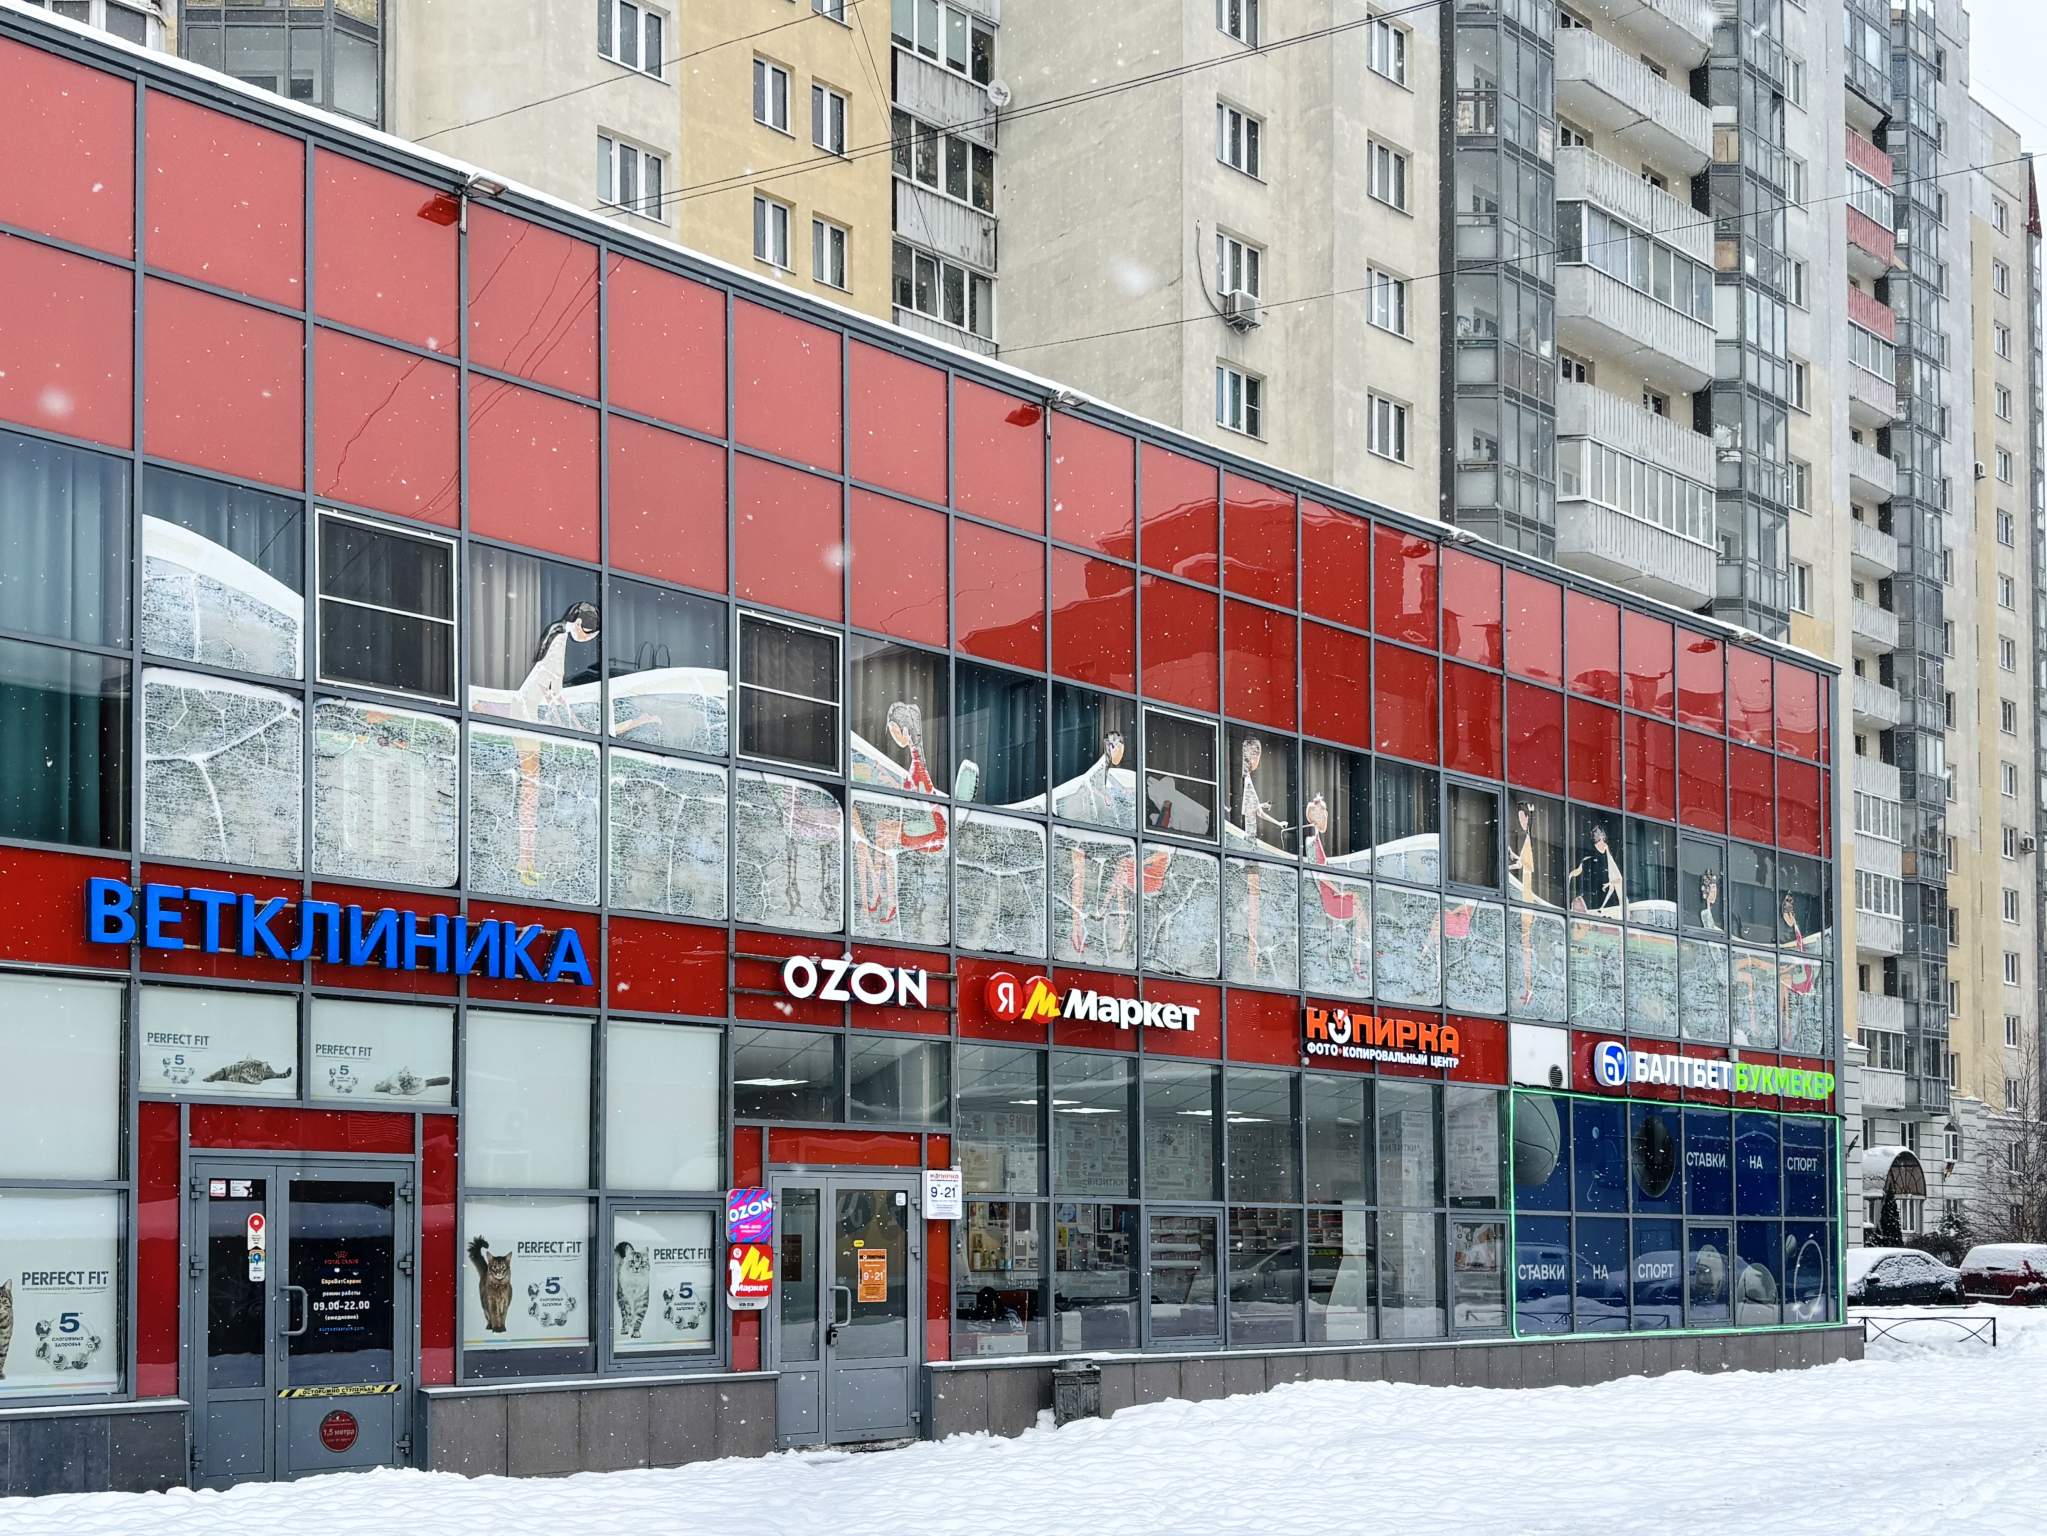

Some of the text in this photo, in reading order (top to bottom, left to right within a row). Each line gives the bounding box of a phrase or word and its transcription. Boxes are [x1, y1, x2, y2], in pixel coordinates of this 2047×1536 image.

[85, 876, 594, 986] ВЕТКЛИНИКА
[783, 955, 928, 1009] OZON
[996, 986, 1015, 1014] Я
[1062, 988, 1201, 1032] Маркет
[147, 1032, 210, 1046] PERFECT FIT
[1305, 1006, 1460, 1055] КОПИРКА
[315, 1043, 373, 1057] PERFECT FIT
[174, 1054, 185, 1065] 5
[1430, 1055, 1460, 1069] ЦЕНТР
[339, 1065, 350, 1076] 5
[1631, 1050, 1835, 1100] БАЛТБЕТ БУКМЕКЕР
[1686, 1151, 1818, 1172] СТАВКИ НА СПОРТ
[729, 1197, 773, 1222] OZON
[517, 1241, 584, 1254] PERFECT FIT
[653, 1248, 713, 1260] PERFECT FIT
[21, 1270, 109, 1286] PERFECT FIT
[1518, 1263, 1674, 1280] СТАВКИ НА СПОРТ
[545, 1276, 561, 1295] 5
[678, 1281, 693, 1299] 5
[59, 1312, 81, 1333] 5
